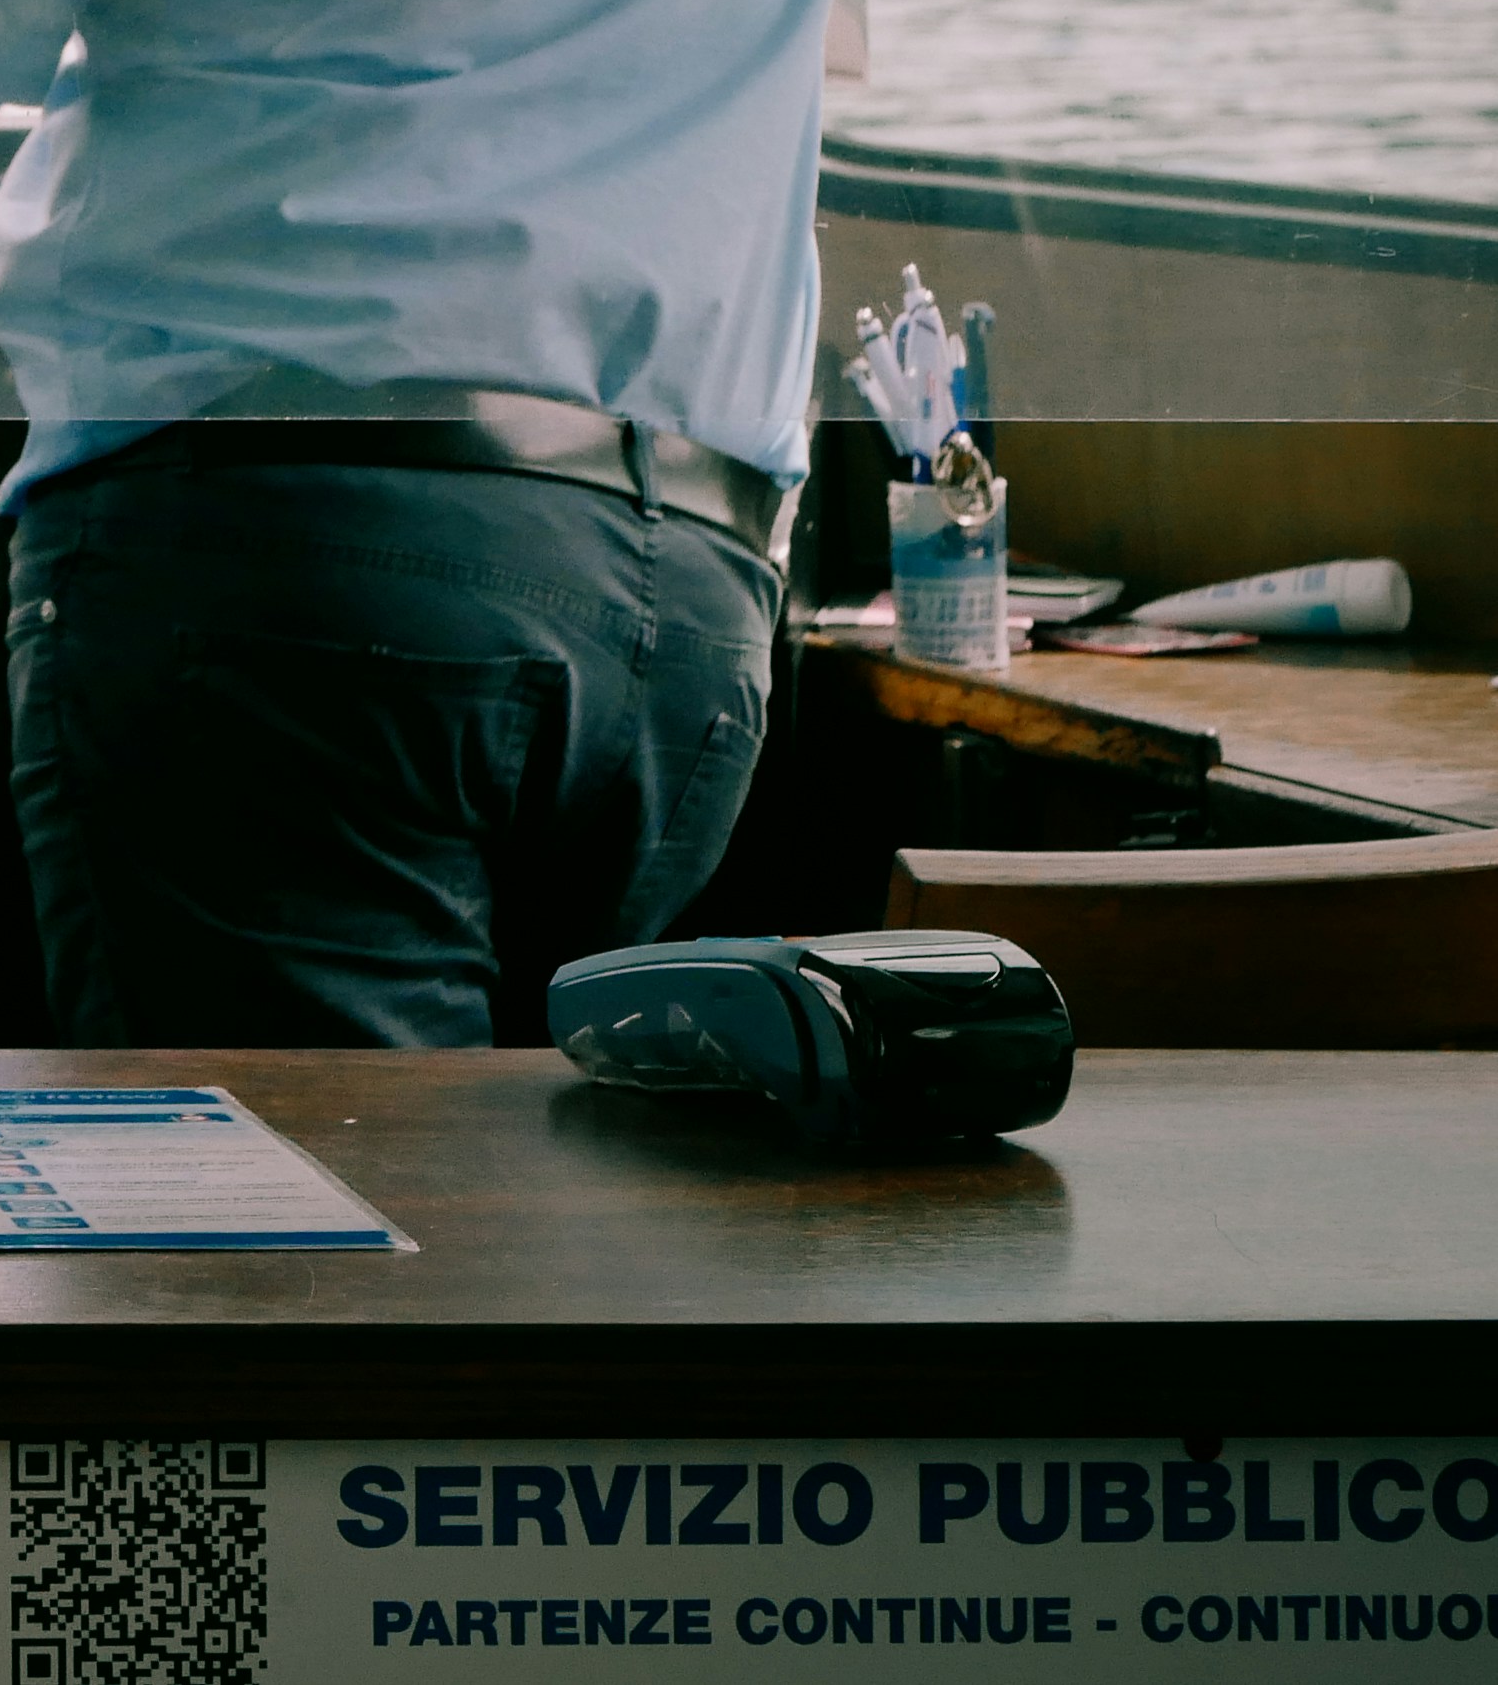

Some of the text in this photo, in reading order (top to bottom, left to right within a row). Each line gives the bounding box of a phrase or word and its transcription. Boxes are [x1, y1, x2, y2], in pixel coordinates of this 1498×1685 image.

[336, 1458, 1498, 1548] SERVIZIO PUBBLICO
[372, 1598, 711, 1646] PARTENZE
[735, 1596, 1071, 1645] CONTINUE
[1140, 1593, 1498, 1643] CONTINUO
